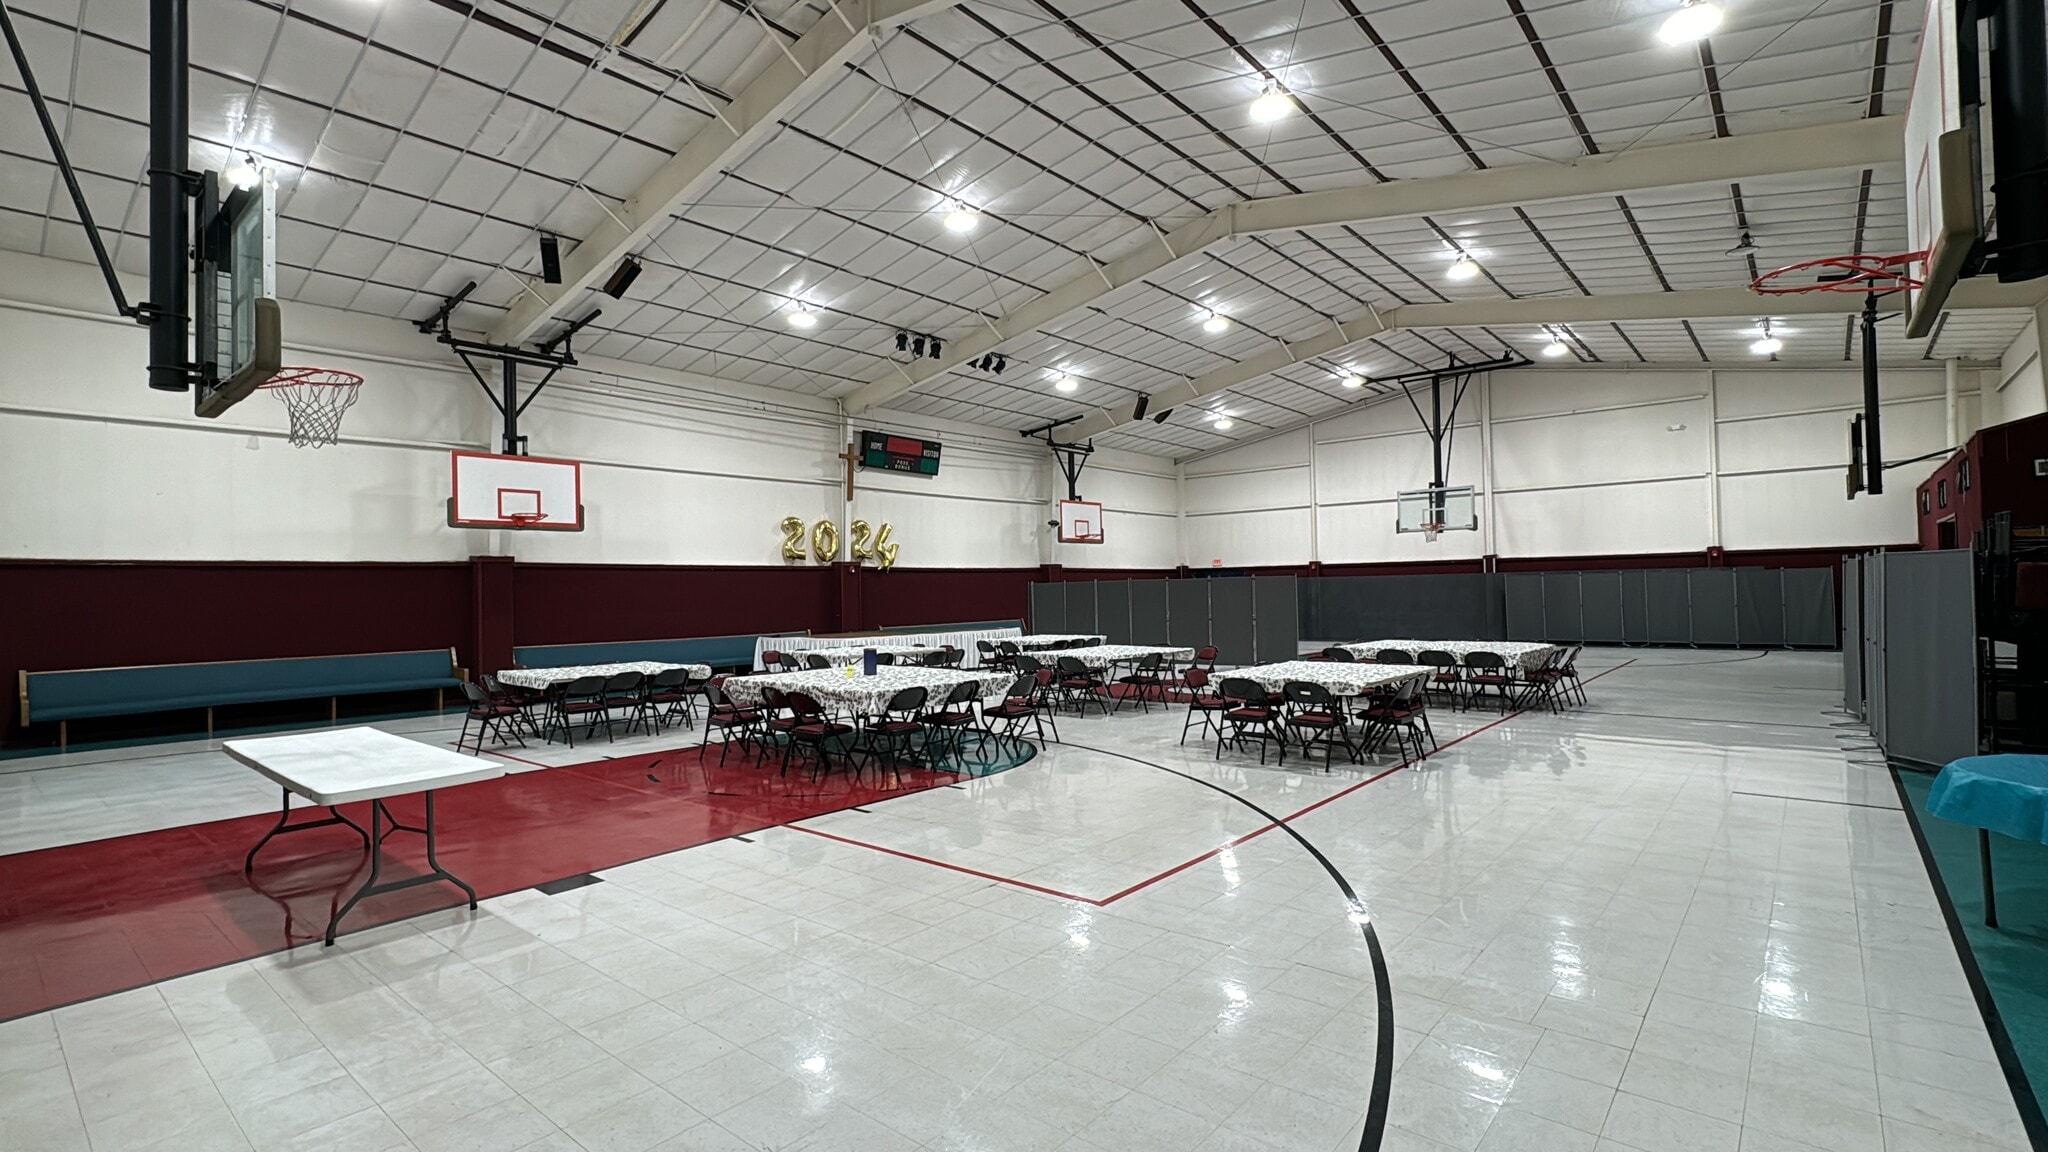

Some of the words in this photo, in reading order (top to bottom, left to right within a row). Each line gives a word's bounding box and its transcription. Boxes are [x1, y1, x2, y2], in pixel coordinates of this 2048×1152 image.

[870, 441, 883, 451] HOME
[923, 449, 939, 458] VISITOR
[780, 516, 899, 570] 2024
